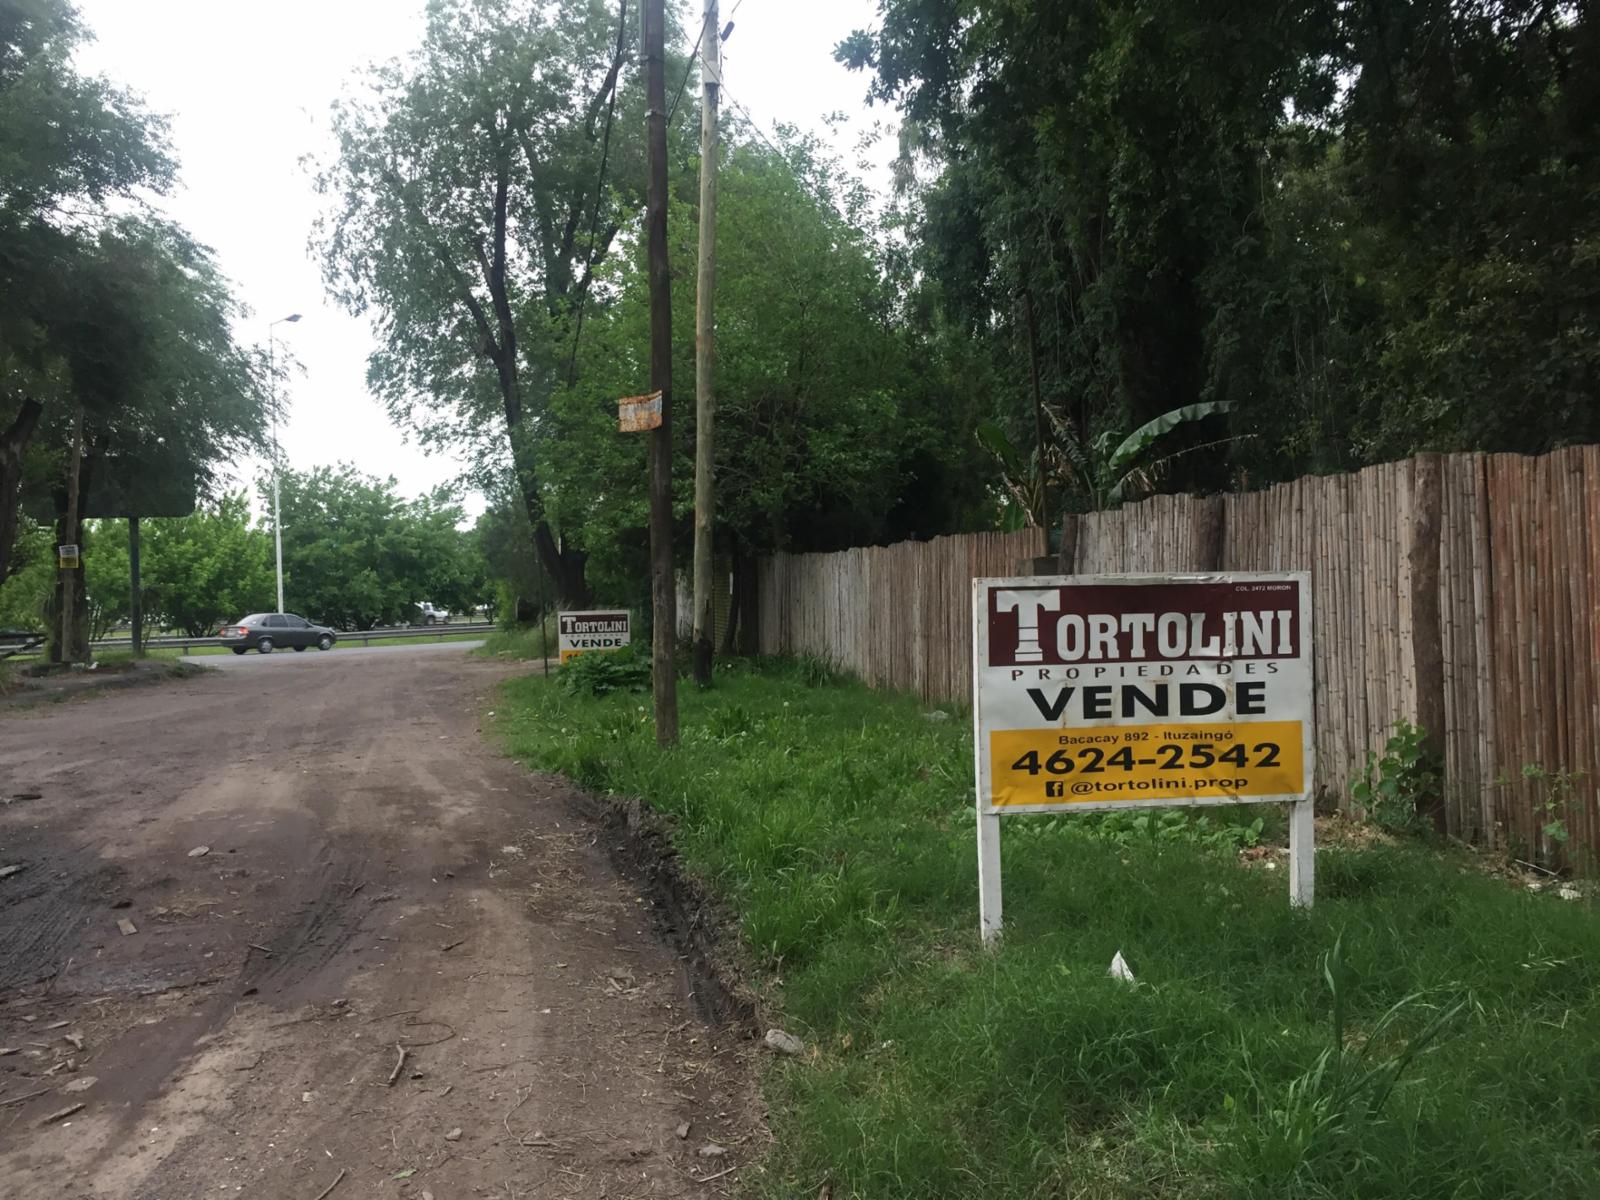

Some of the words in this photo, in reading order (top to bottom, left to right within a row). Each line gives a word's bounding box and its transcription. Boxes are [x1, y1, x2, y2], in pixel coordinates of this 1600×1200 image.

[562, 616, 626, 632] TORTOLINI
[996, 588, 1293, 662] TORTOLINI
[570, 639, 622, 648] VENDE
[1011, 661, 1279, 681] PROPIEDADES
[1026, 681, 1266, 722] VENDE
[1058, 734, 1119, 746] Bacacay
[1124, 731, 1149, 742] 892
[1011, 742, 1281, 776] 4624-2542
[1070, 776, 1249, 796] @tortolini.prop
